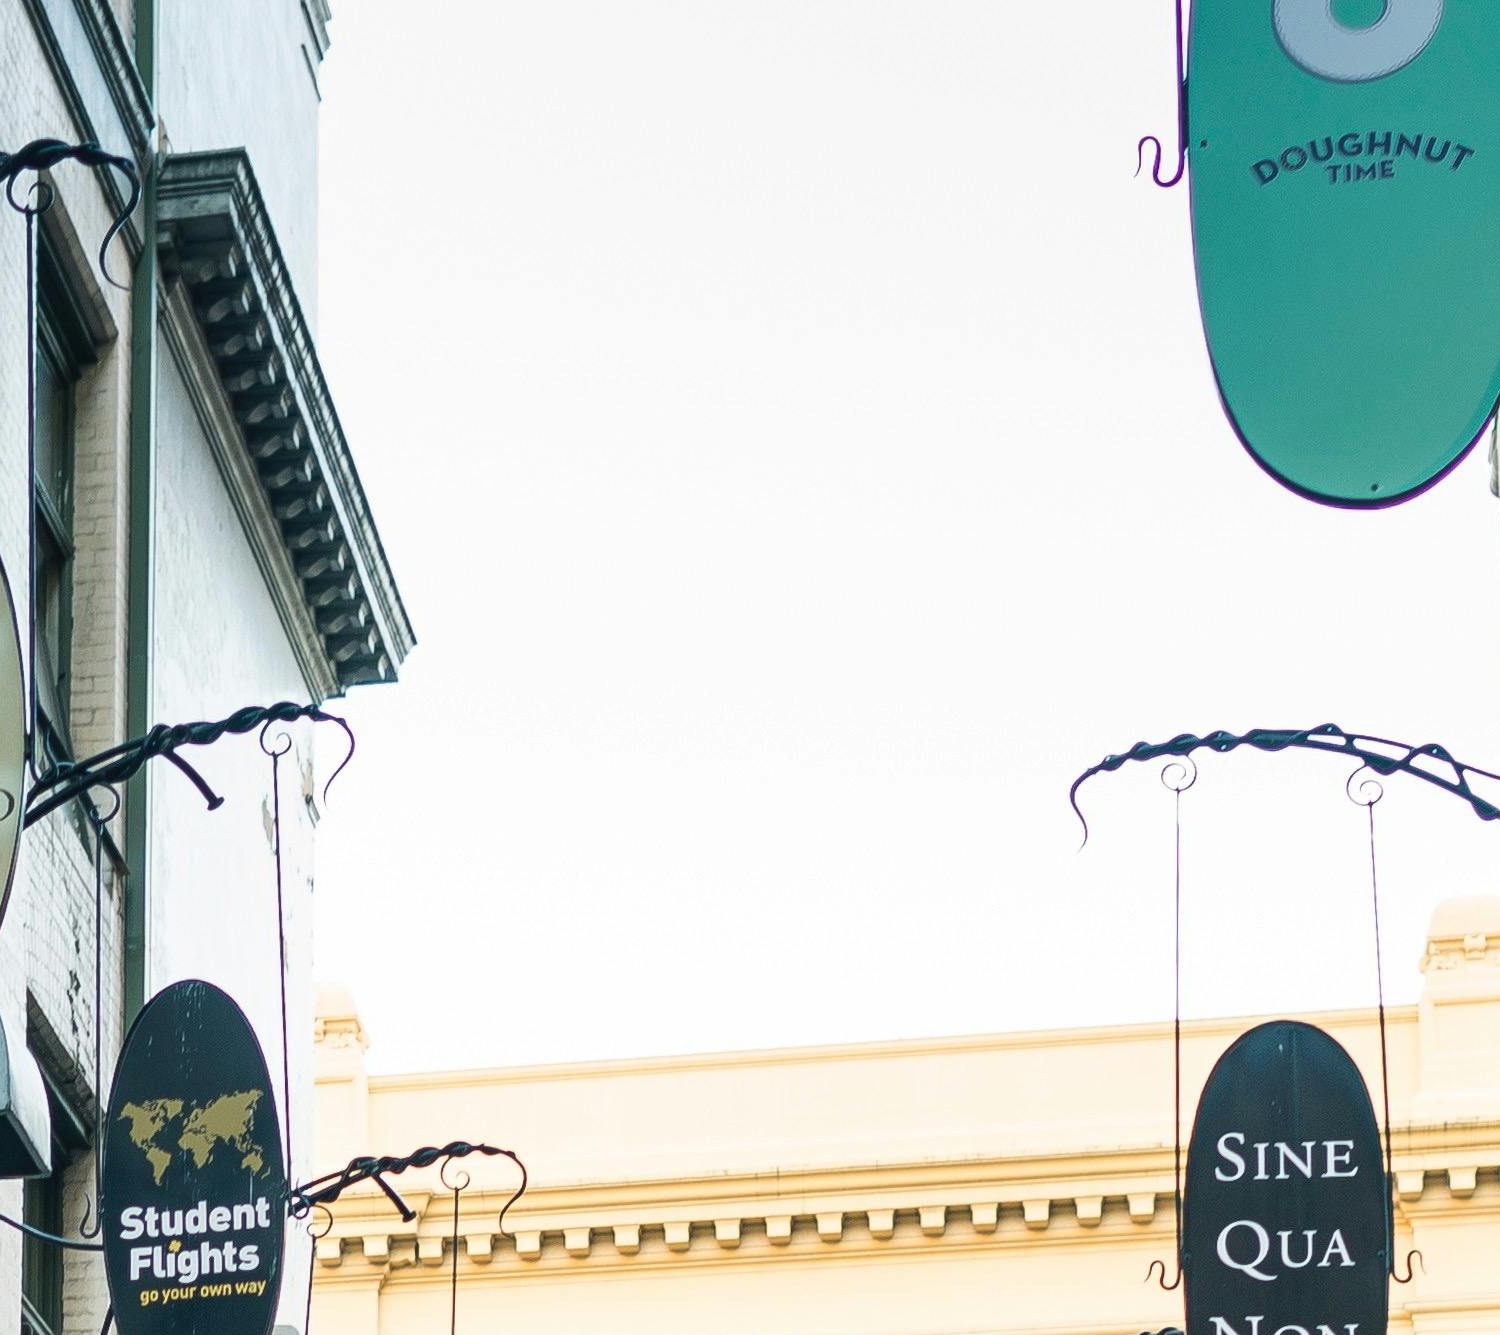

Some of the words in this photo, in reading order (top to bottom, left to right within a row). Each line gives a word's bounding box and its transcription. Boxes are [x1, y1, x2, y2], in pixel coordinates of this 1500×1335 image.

[1250, 130, 1476, 187] DOUGHNUT
[1326, 159, 1396, 184] TIME
[1213, 1131, 1359, 1182] SINE
[119, 1196, 272, 1241] Student
[129, 1238, 261, 1285] Flights
[1215, 1219, 1357, 1280] QUA
[140, 1288, 160, 1307] go
[162, 1283, 197, 1306] your
[199, 1282, 233, 1300] own
[235, 1278, 268, 1299] way
